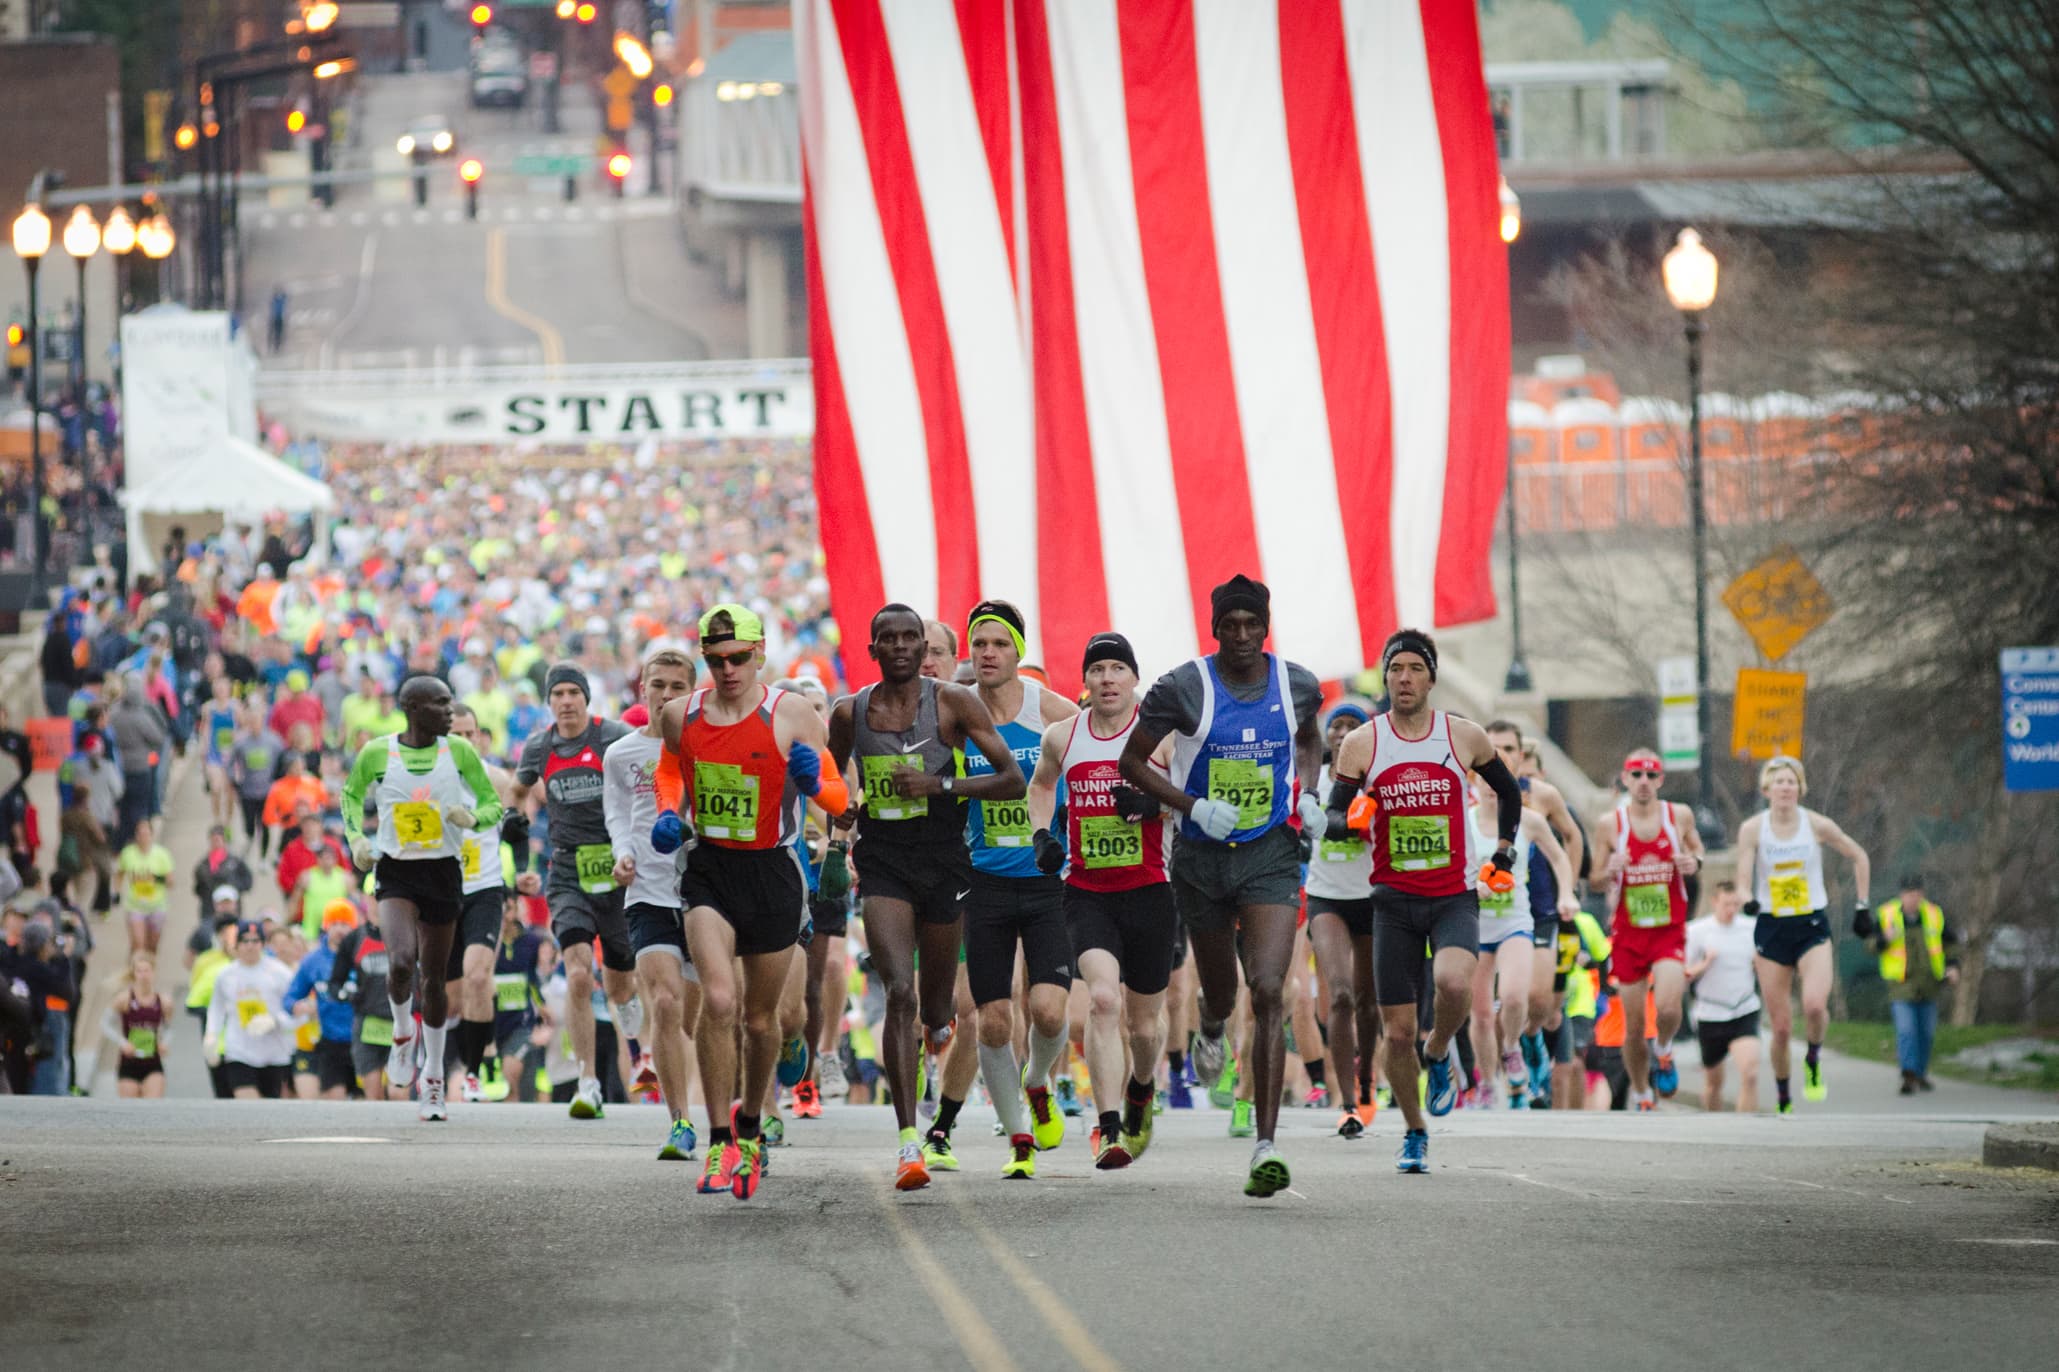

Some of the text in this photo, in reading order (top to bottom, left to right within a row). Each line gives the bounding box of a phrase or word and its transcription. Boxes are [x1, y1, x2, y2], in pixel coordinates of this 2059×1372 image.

[506, 388, 786, 434] START
[1379, 779, 1451, 798] RUNNERS
[698, 793, 754, 818] 1041
[1383, 793, 1451, 811] MARKET
[986, 807, 1031, 826] 100
[412, 819, 422, 834] 3
[1086, 836, 1140, 858] 1003
[1394, 835, 1447, 855] 1004
